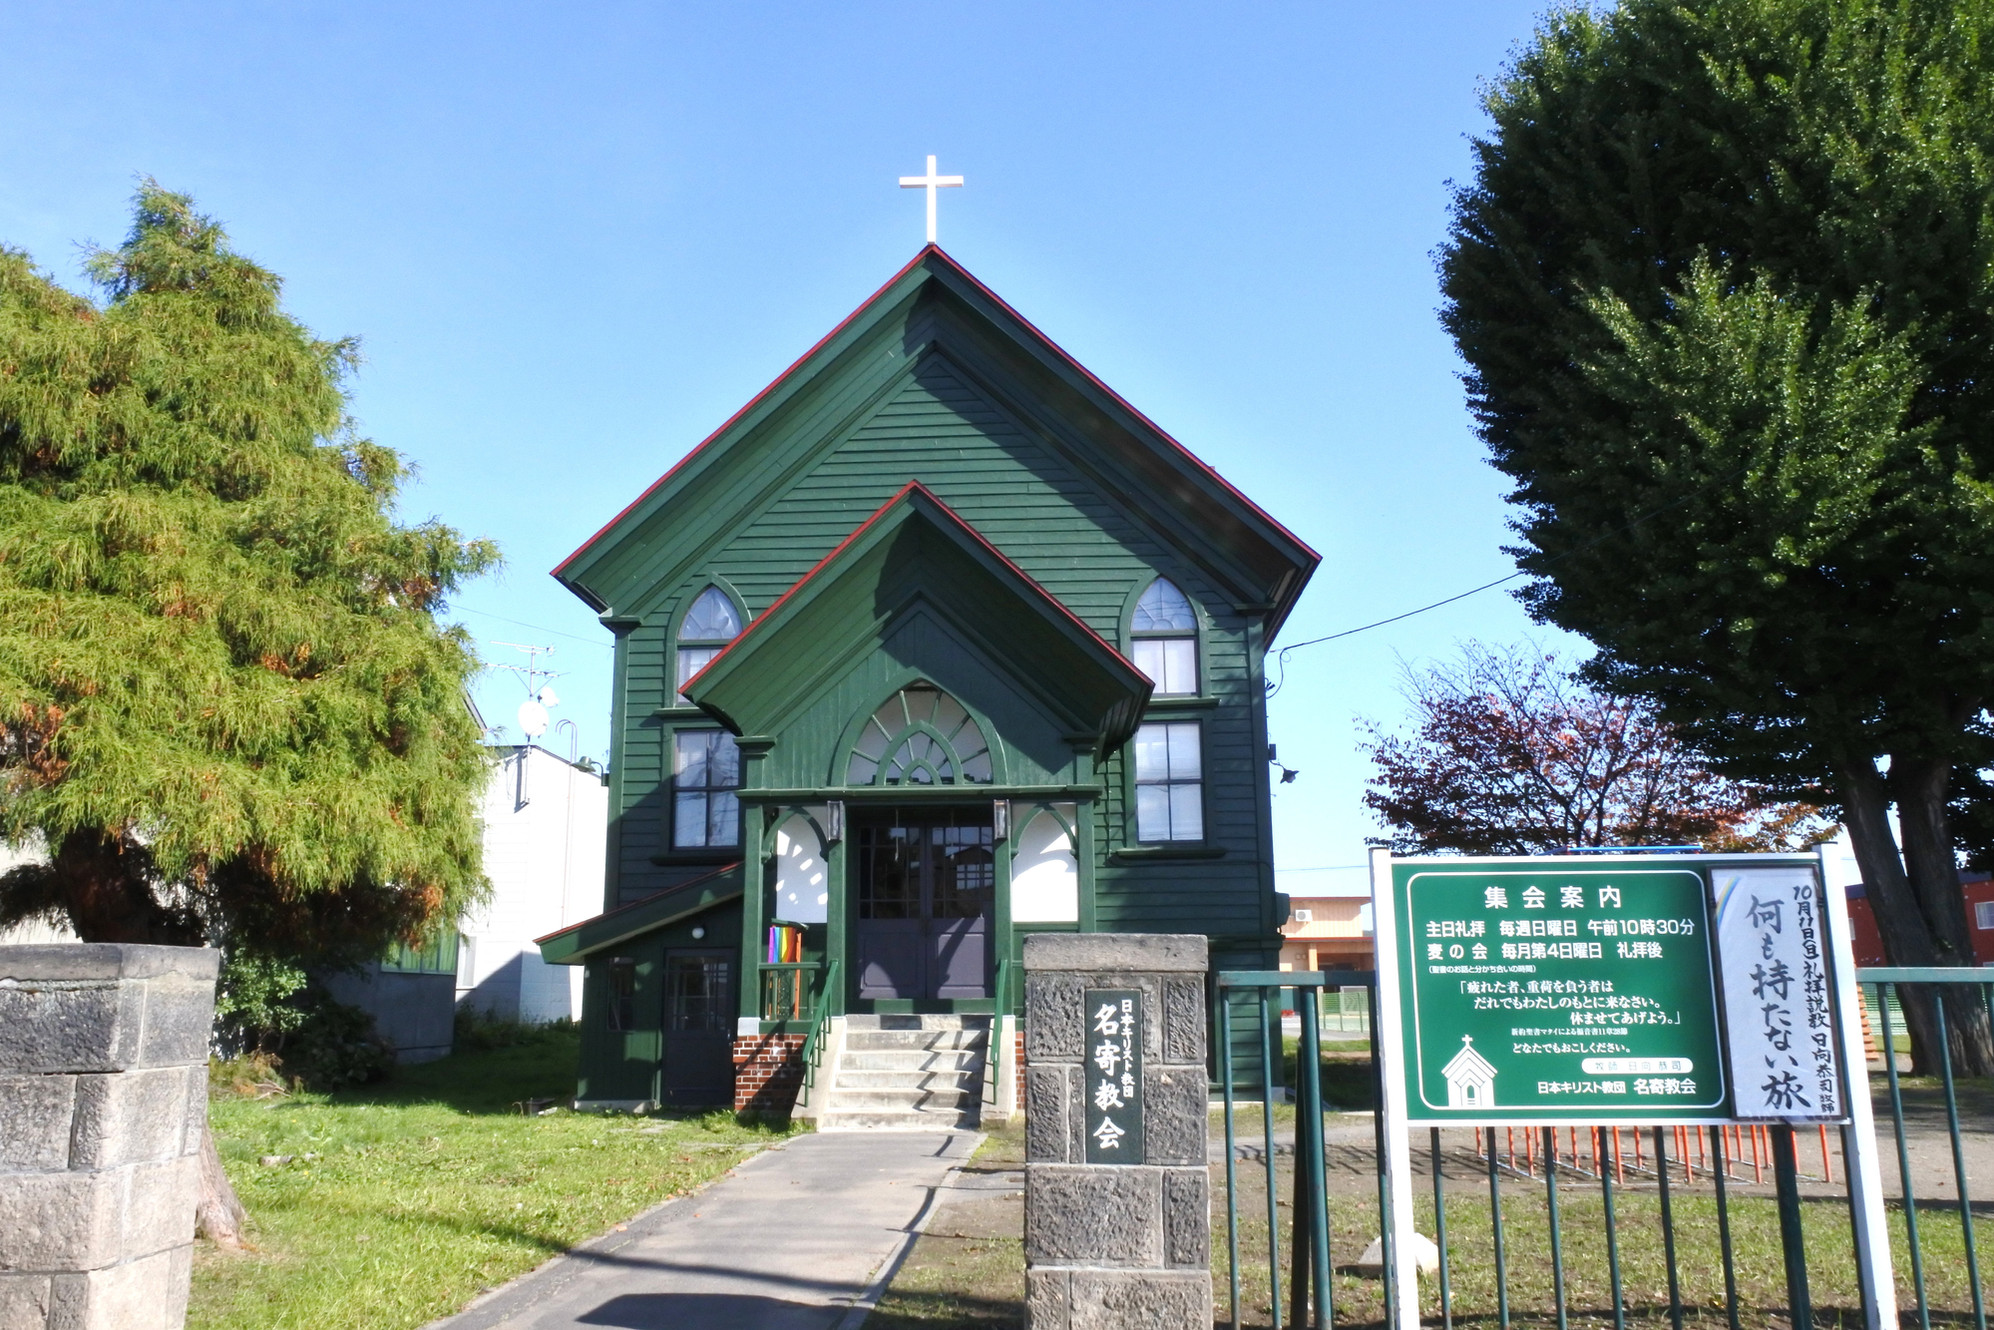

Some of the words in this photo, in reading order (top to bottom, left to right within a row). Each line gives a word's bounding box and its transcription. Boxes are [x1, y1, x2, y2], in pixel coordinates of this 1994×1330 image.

[1484, 885, 1622, 909] 集会案内
[1426, 921, 1486, 938] 主日礼拝
[1499, 920, 1578, 937] 毎週日曜日
[1587, 918, 1695, 936] 午前10時30分
[1501, 942, 1603, 960] 毎月第4日曜日
[1617, 942, 1663, 959] 礼拝後
[1474, 996, 1661, 1010] だれでもわたしのもとに来なさい。
[1745, 894, 1812, 1110] 何も持たない旅
[1570, 1011, 1681, 1025] 休ませてあげよう。」
[1120, 999, 1136, 1098] 日本キリスト教団
[1512, 1043, 1632, 1054] どなたでもおこしください。
[1093, 1003, 1125, 1149] 名寄教会
[1537, 1081, 1627, 1095] 日本キリスト教団
[1633, 1078, 1697, 1096] 名寄教会
